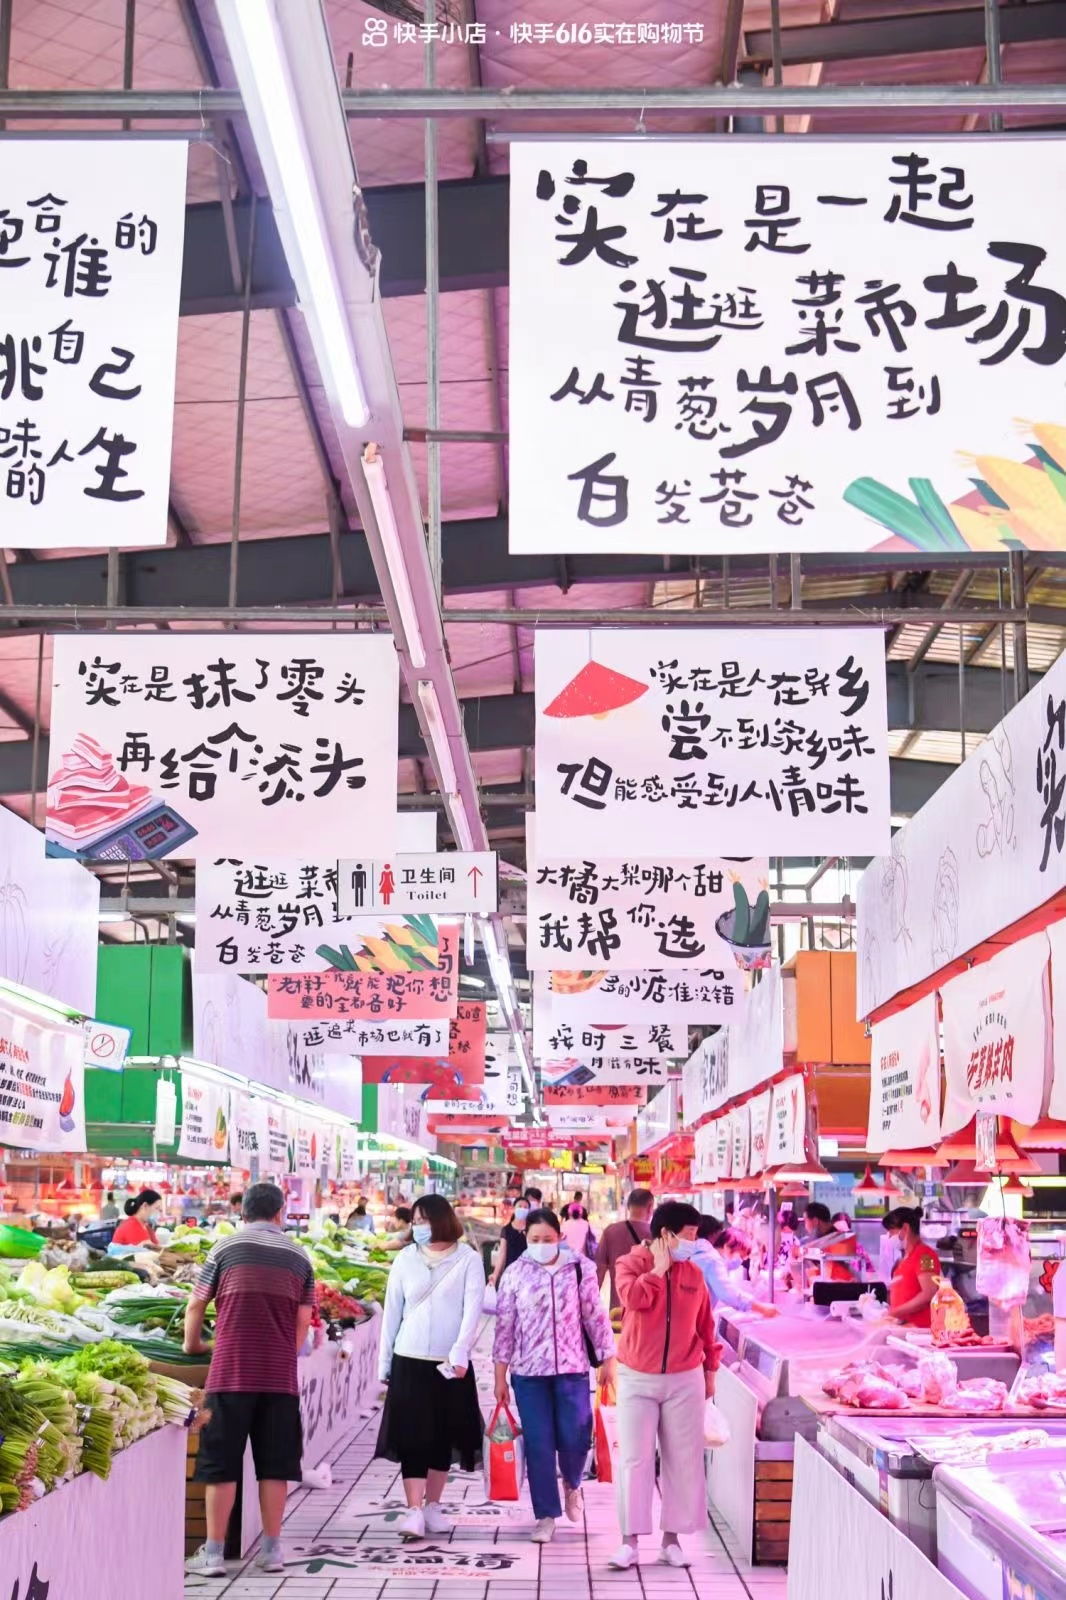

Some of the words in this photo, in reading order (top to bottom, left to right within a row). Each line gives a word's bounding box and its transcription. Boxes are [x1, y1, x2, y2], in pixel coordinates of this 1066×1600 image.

[537, 153, 974, 267] 实在是一起
[612, 240, 1066, 366] 逛逛菜市场
[548, 354, 943, 460] 从青葱岁月到
[568, 450, 814, 526] 白发苍苍
[79, 657, 365, 716] 实在是抹了零头
[649, 654, 871, 718] 实在是人在异乡
[117, 723, 367, 805] 再给个添头
[660, 698, 877, 771] 尝不到家乡味
[556, 757, 869, 818] 但能感受到人情味
[400, 866, 455, 884] 卫生间
[406, 890, 447, 901] Toilet
[537, 861, 723, 906] 大橘大梨哪个甜
[215, 936, 306, 965] 白发苍苍
[540, 902, 705, 960] 我帮你选
[599, 974, 736, 1006] 多的小店准没错
[548, 1024, 675, 1053] 按时三餐
